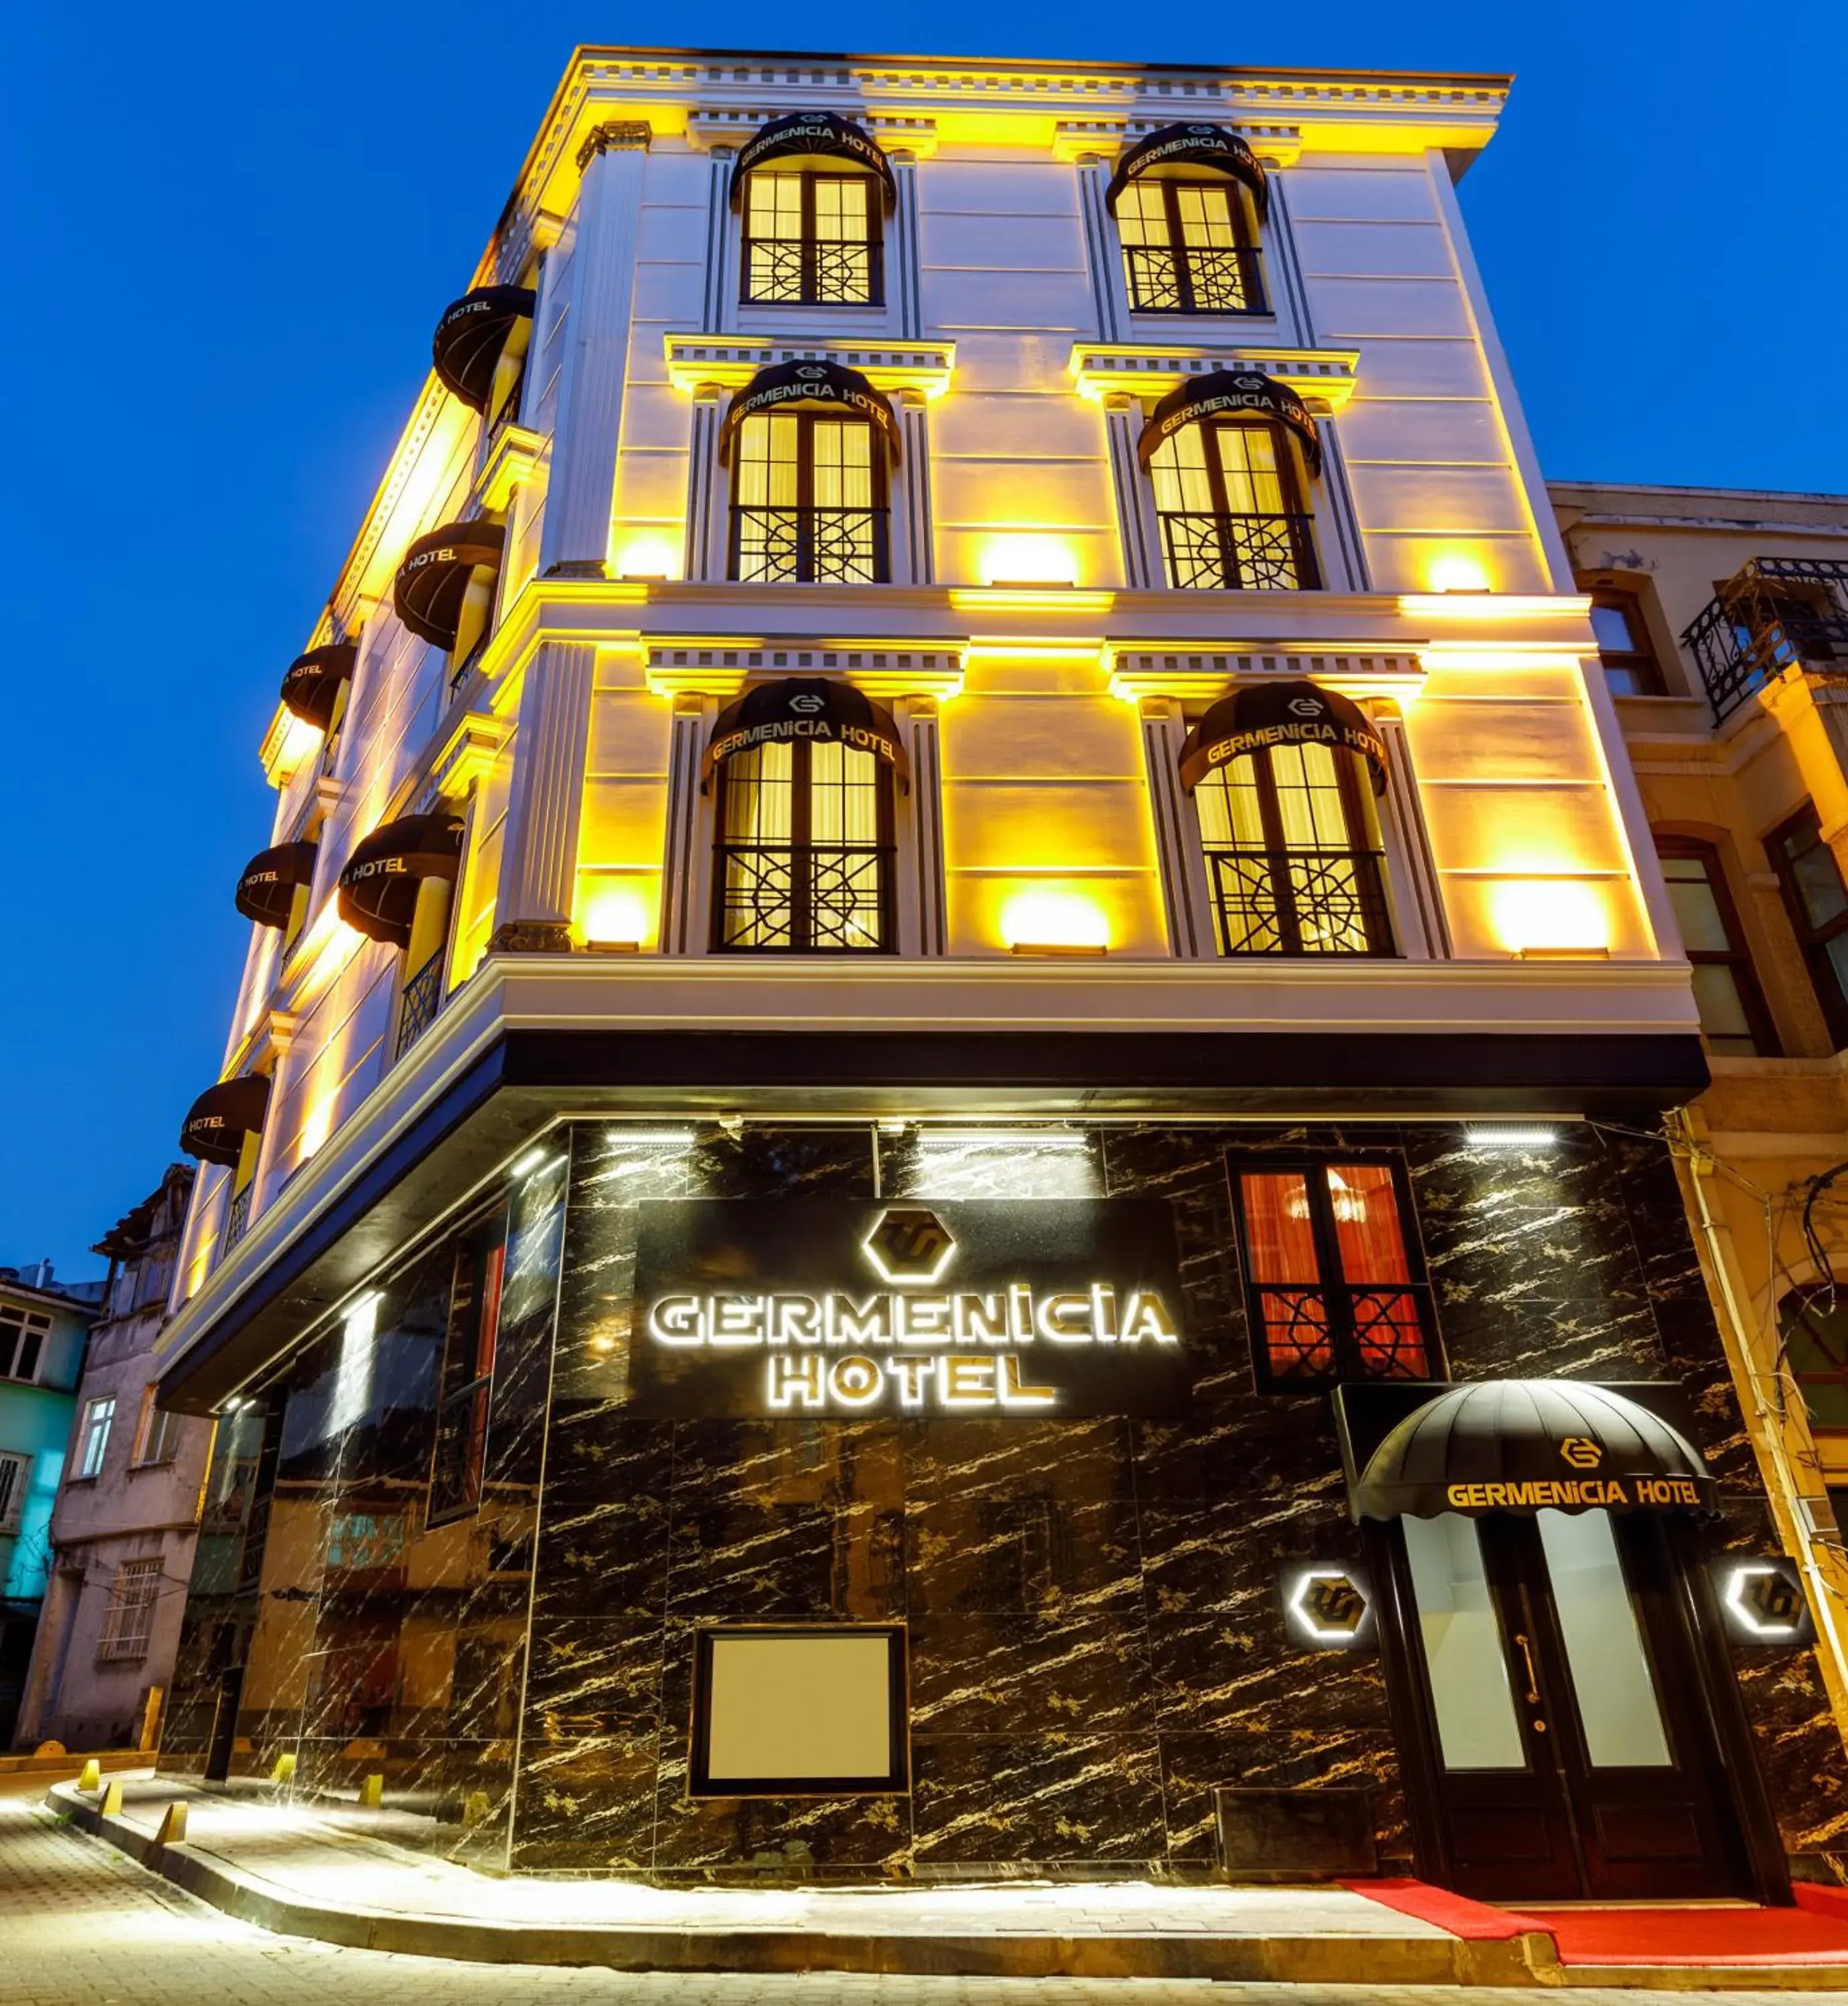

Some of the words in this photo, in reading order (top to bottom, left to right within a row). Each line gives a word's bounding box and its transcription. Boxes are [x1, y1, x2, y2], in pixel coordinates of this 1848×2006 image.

[447, 301, 491, 325] HOTEL
[842, 388, 889, 429] HOTEL
[409, 548, 457, 570] HOTEL
[840, 724, 895, 762] HOTEL
[245, 871, 279, 886] HOTEL
[352, 857, 407, 881] HOTEL
[189, 1116, 225, 1133] HOTEL
[767, 1355, 1058, 1408] HOTEL
[1636, 1480, 1700, 1504] HOTEL
